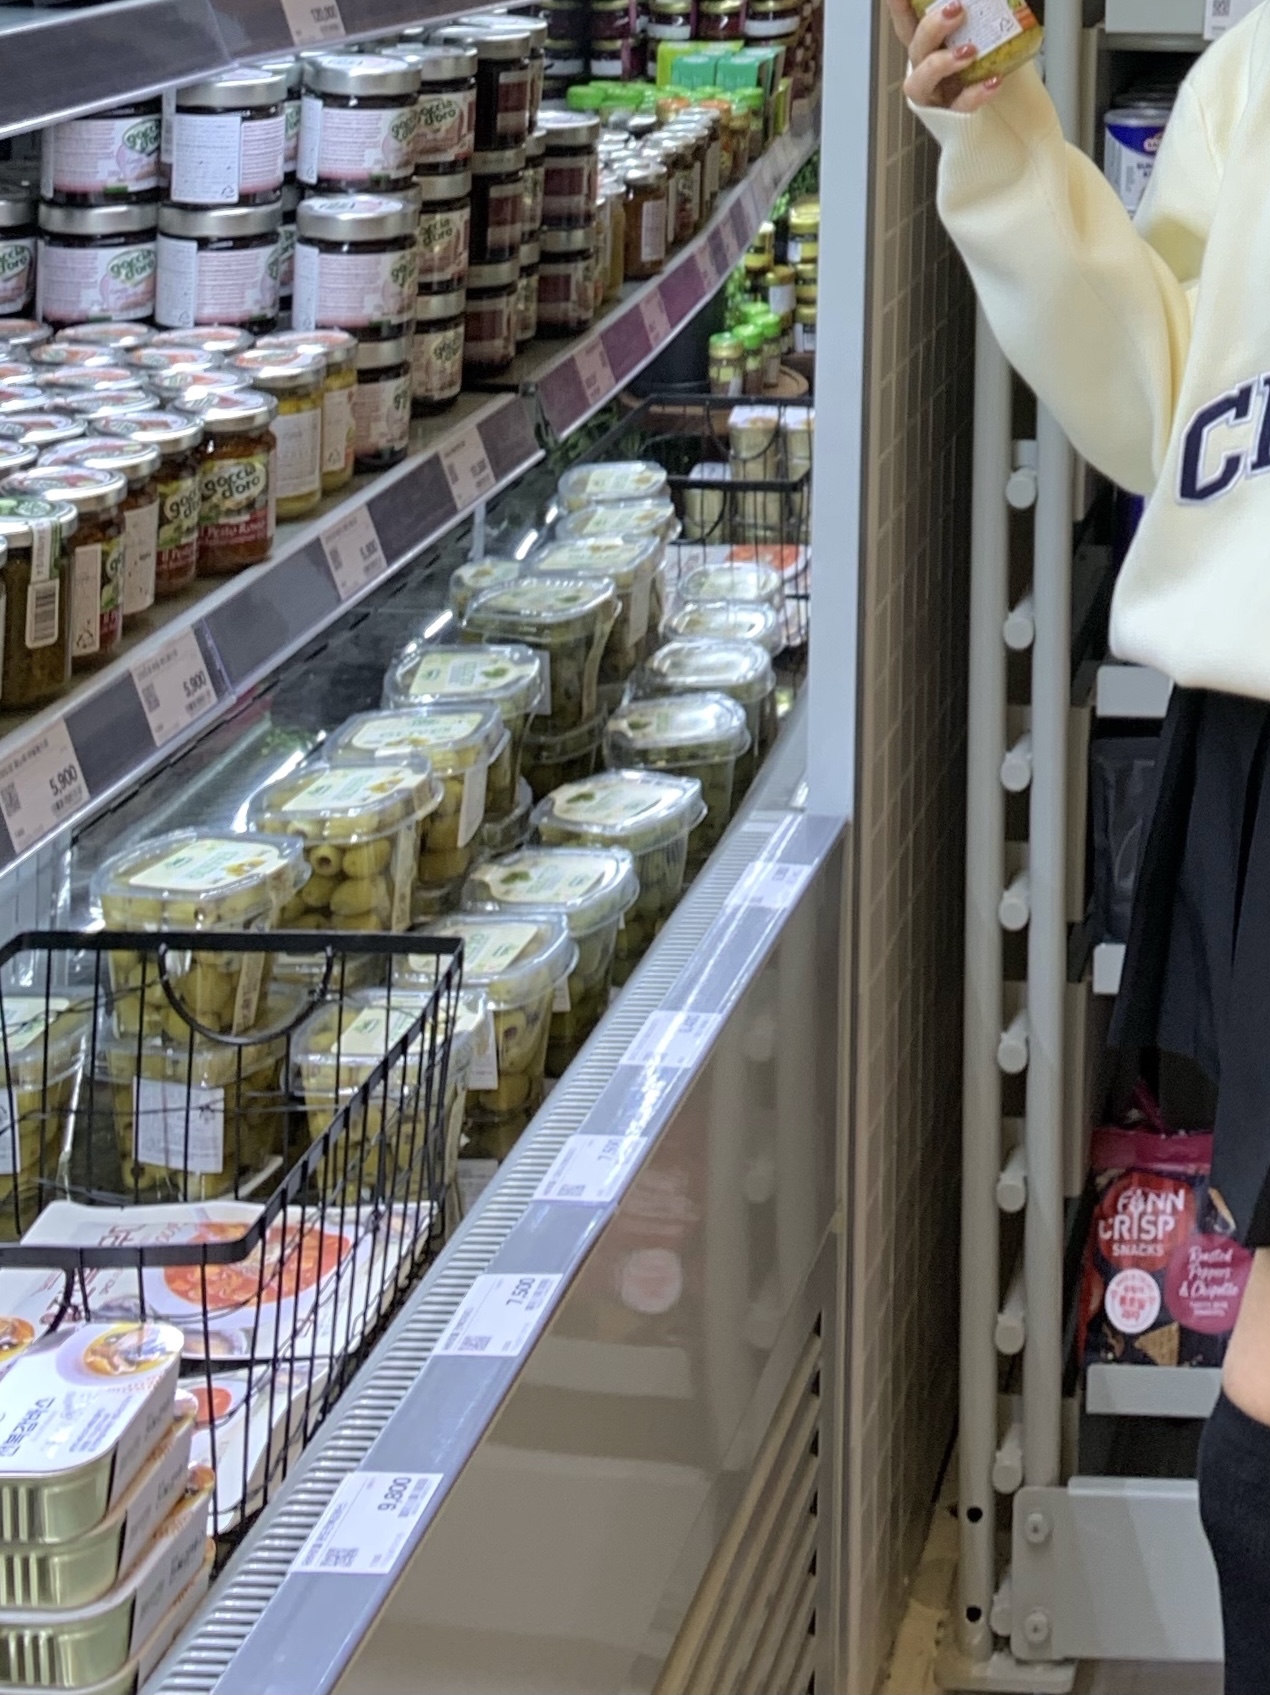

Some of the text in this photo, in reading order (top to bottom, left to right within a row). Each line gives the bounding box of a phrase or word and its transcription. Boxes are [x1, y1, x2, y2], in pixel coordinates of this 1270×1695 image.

[49, 763, 79, 797] 5,900
[1112, 1242, 1165, 1257] SNACKS
[506, 1276, 537, 1307] 7,500
[377, 1476, 413, 1512] 9,800
